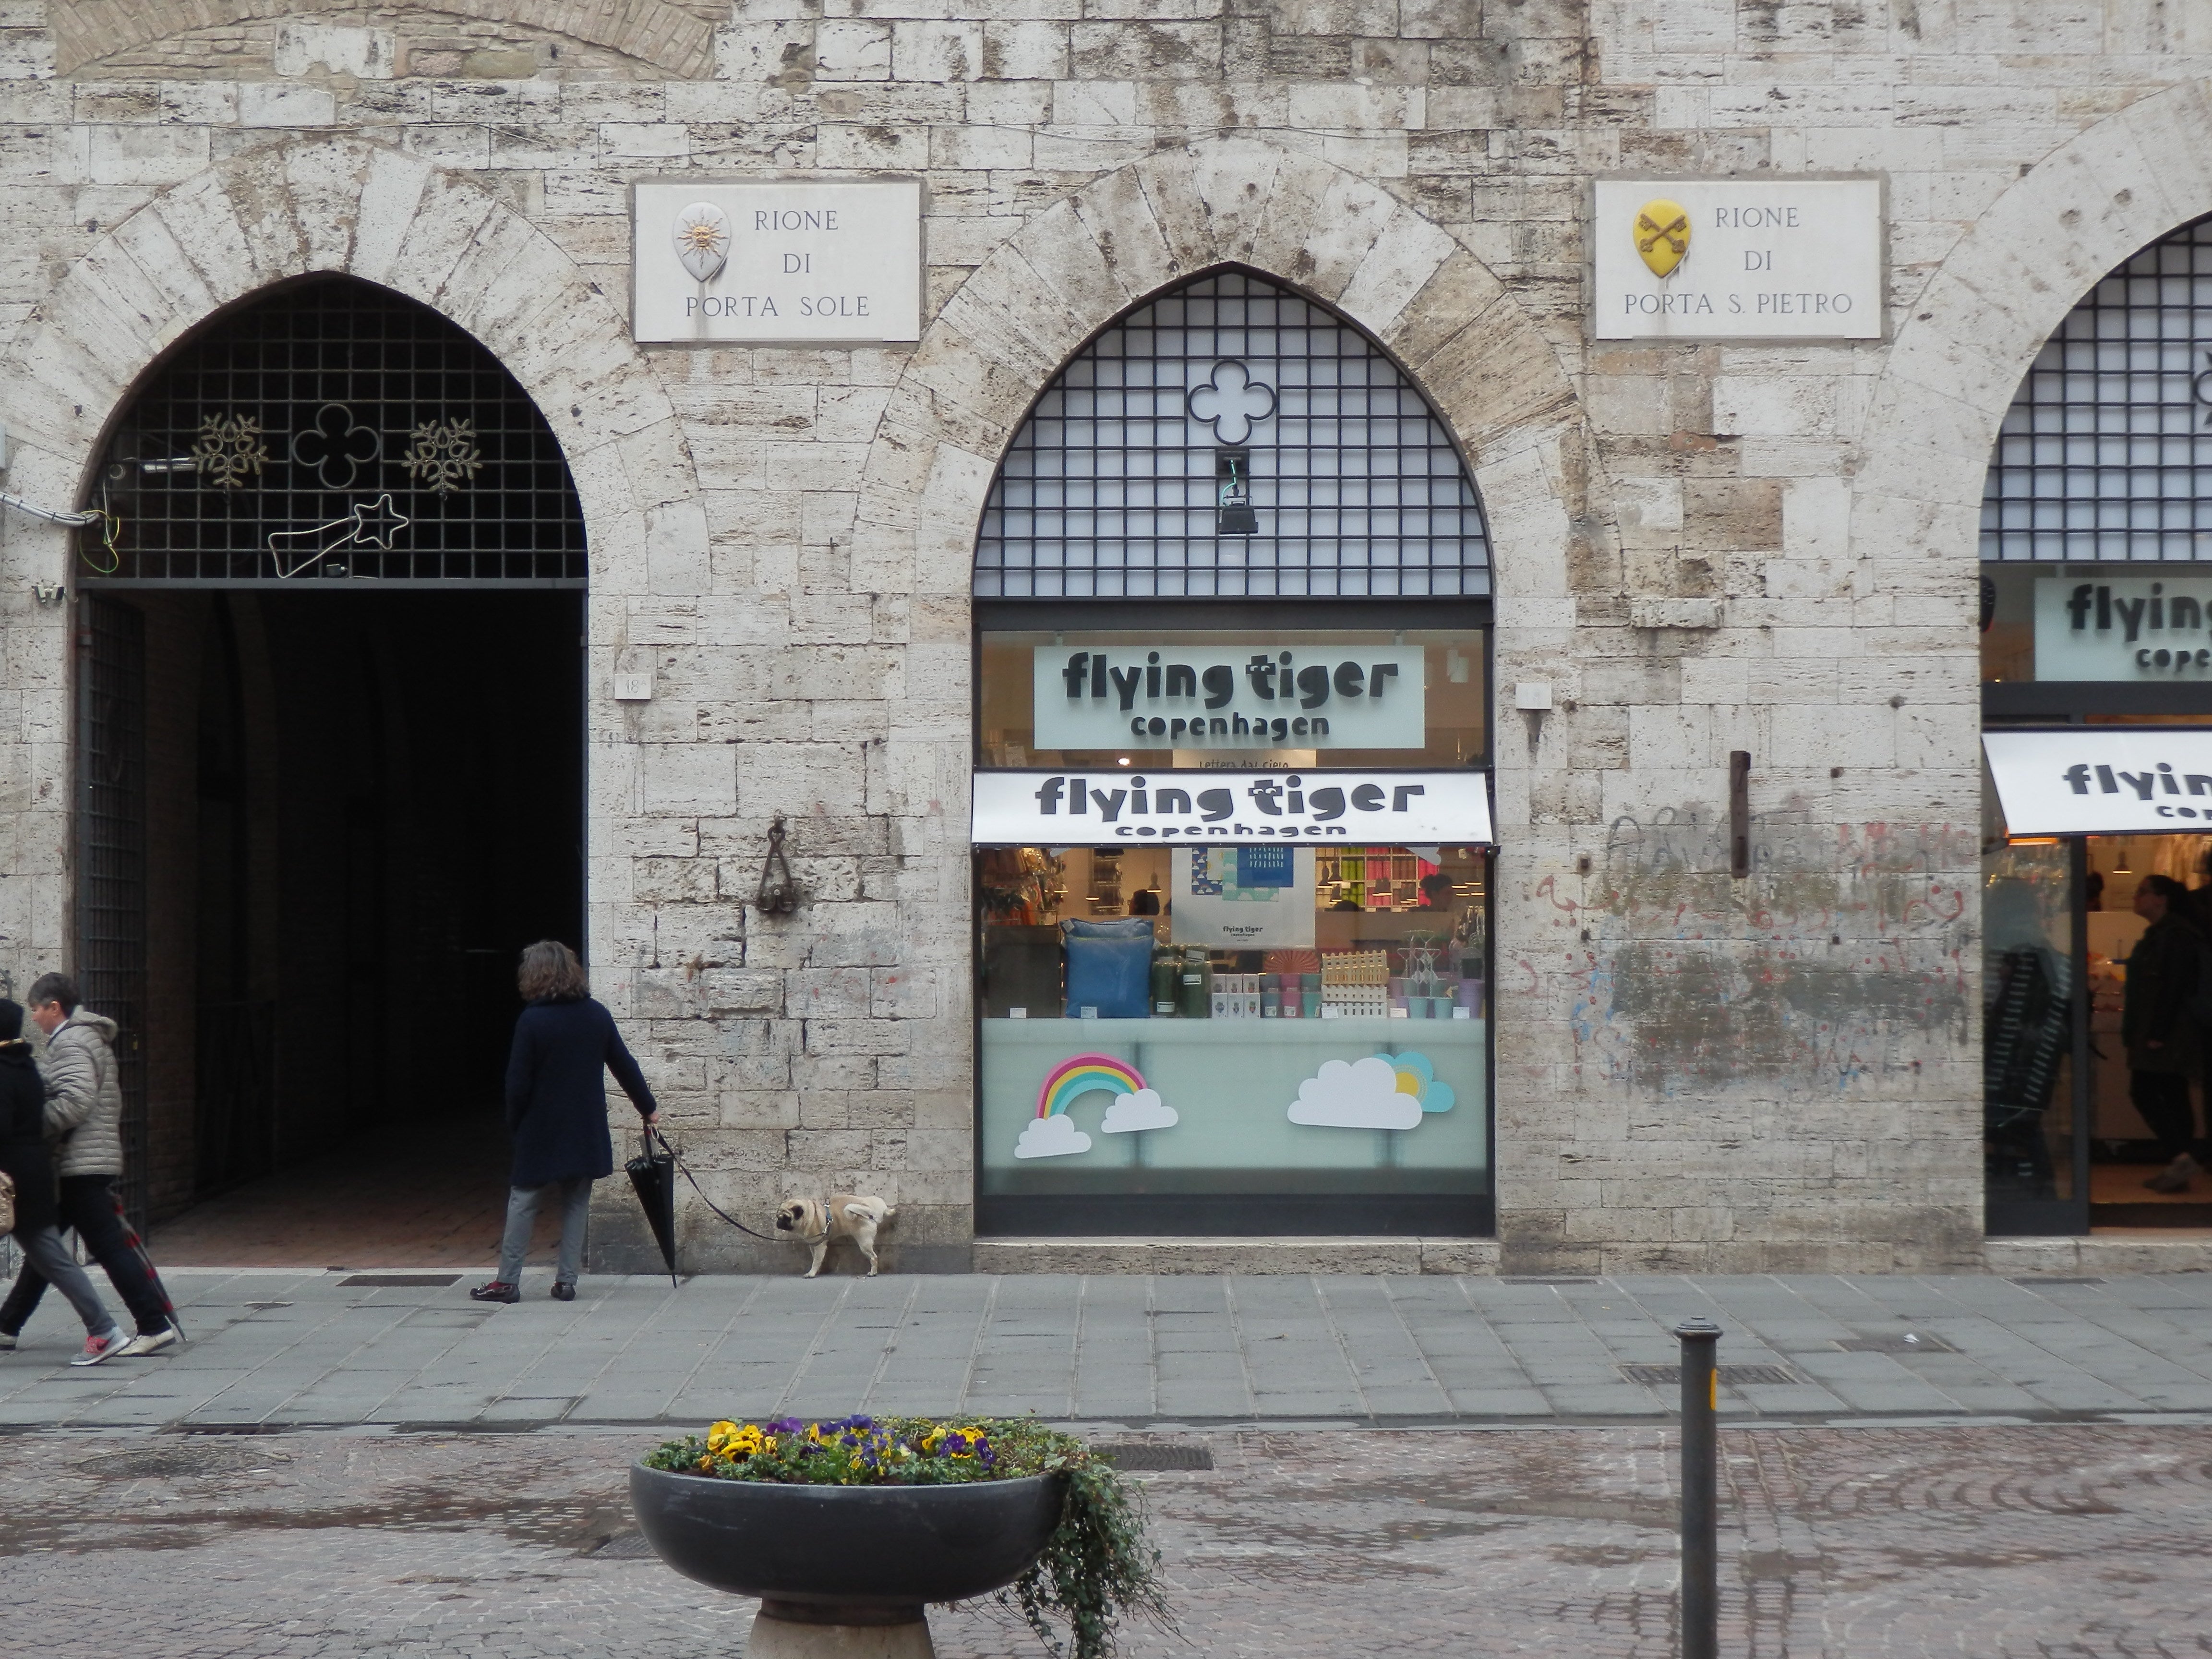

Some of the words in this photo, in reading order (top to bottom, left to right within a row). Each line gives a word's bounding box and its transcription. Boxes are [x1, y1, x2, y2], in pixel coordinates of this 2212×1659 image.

[755, 210, 839, 230] RIONE
[1716, 207, 1800, 228] RIONE
[783, 253, 810, 274] DI
[1745, 251, 1771, 271] DI
[686, 296, 779, 317] PORTA
[800, 296, 870, 316] SOLE
[1625, 294, 1714, 314] PORTA
[1729, 294, 1745, 314] S.
[1757, 293, 1852, 314] PIETRO
[2067, 582, 2212, 642] flyin
[1062, 651, 1234, 710] flying
[1246, 651, 1398, 709] tiger
[1130, 712, 1329, 741] copenhagen
[1035, 776, 1234, 822] flying
[1248, 775, 1425, 821] tiger
[1115, 823, 1346, 838] copenhagen
